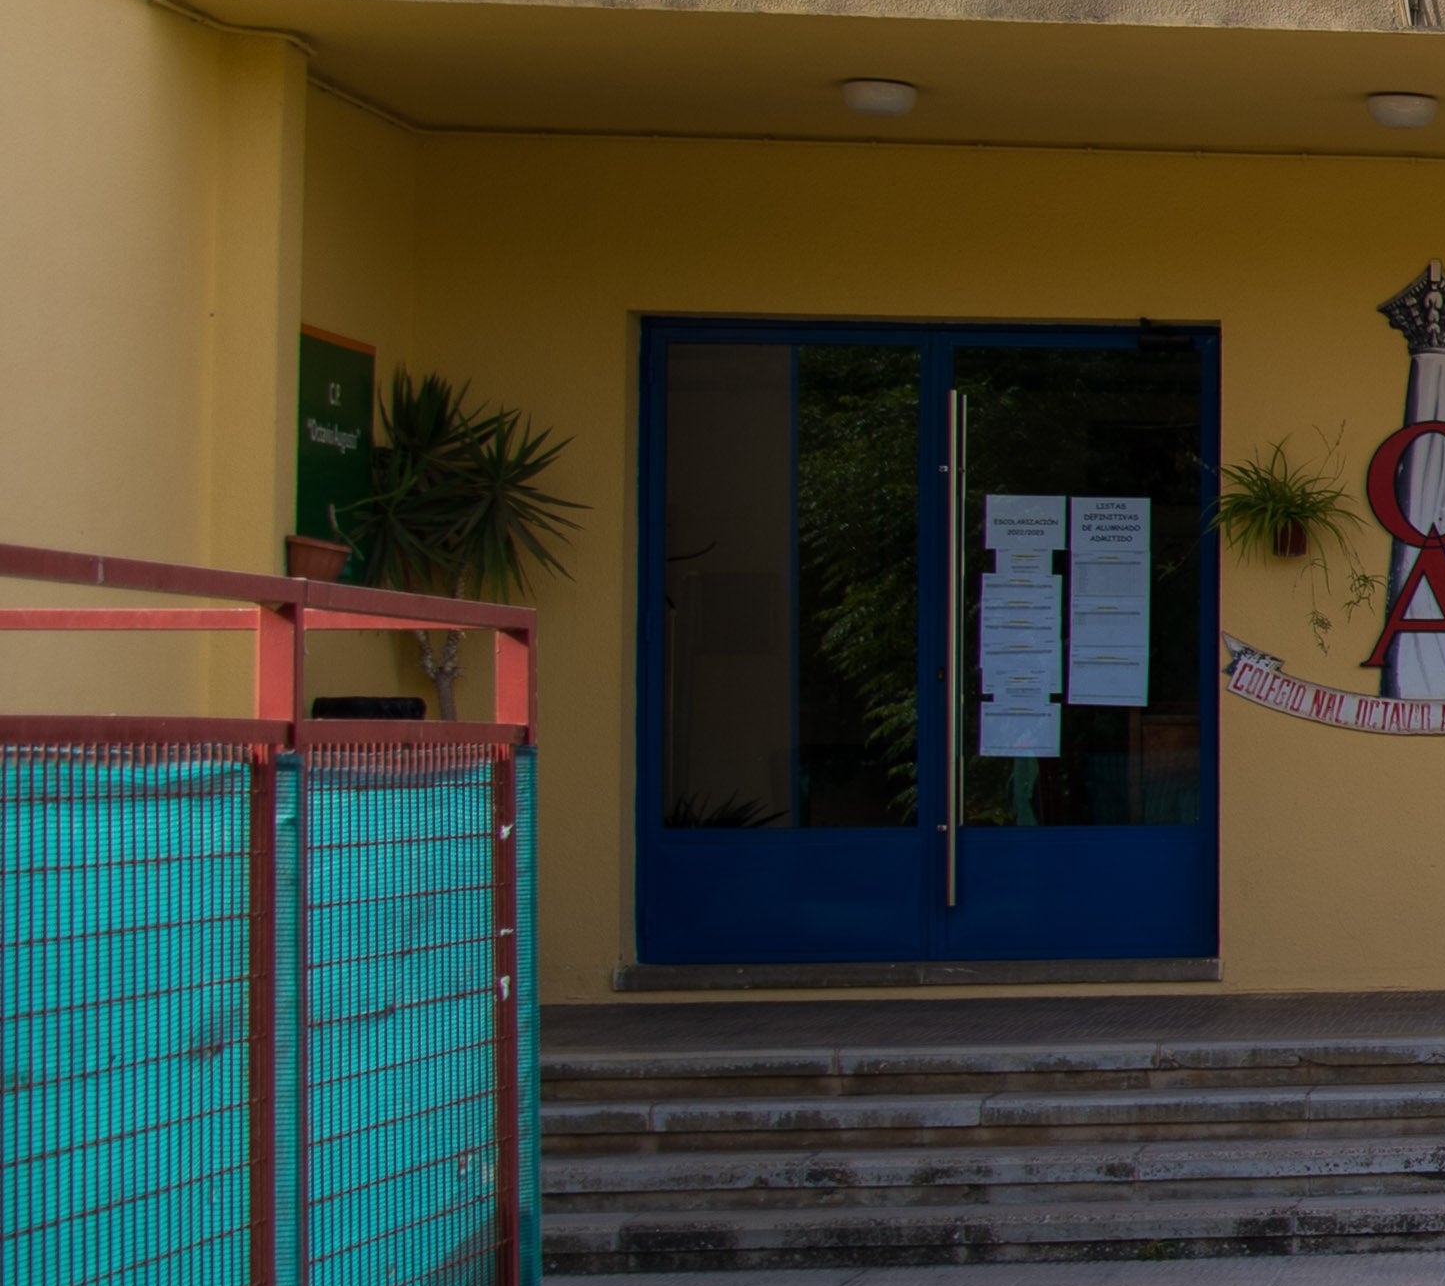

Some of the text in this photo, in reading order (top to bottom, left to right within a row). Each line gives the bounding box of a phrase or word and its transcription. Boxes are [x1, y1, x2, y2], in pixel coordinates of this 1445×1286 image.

[1095, 502, 1127, 510] LISTAS
[993, 517, 1059, 526] ESCOLARIZACIÓN
[1083, 513, 1140, 522] DEFINITIVAS
[1007, 528, 1045, 537] 2022/2023
[1081, 524, 1141, 533] DE ALUMNADO
[1090, 534, 1133, 543] ADMITIDO
[1233, 662, 1307, 712] COLEGIO
